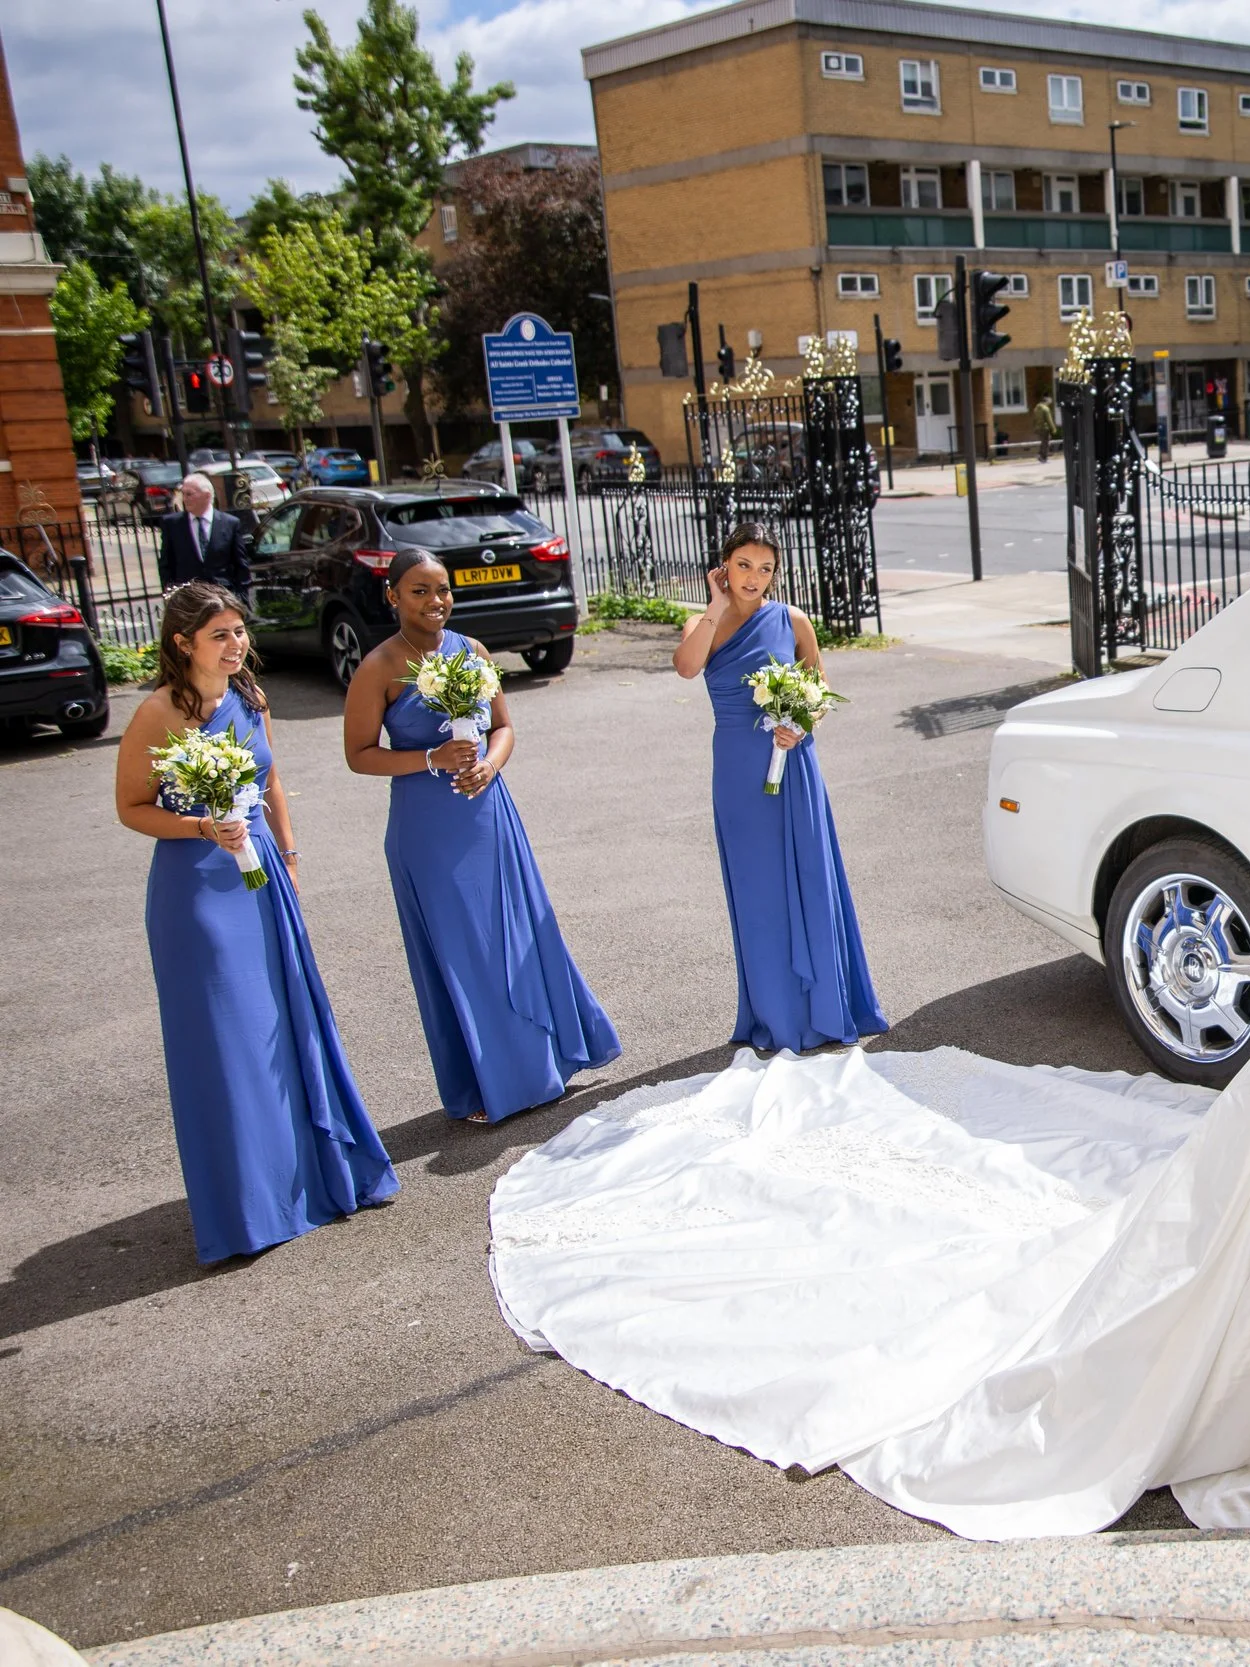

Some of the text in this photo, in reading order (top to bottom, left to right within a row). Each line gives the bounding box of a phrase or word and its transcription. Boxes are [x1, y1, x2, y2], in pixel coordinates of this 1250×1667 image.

[1117, 262, 1126, 278] P
[212, 364, 231, 377] 20
[463, 567, 513, 582] LR17 DVW
